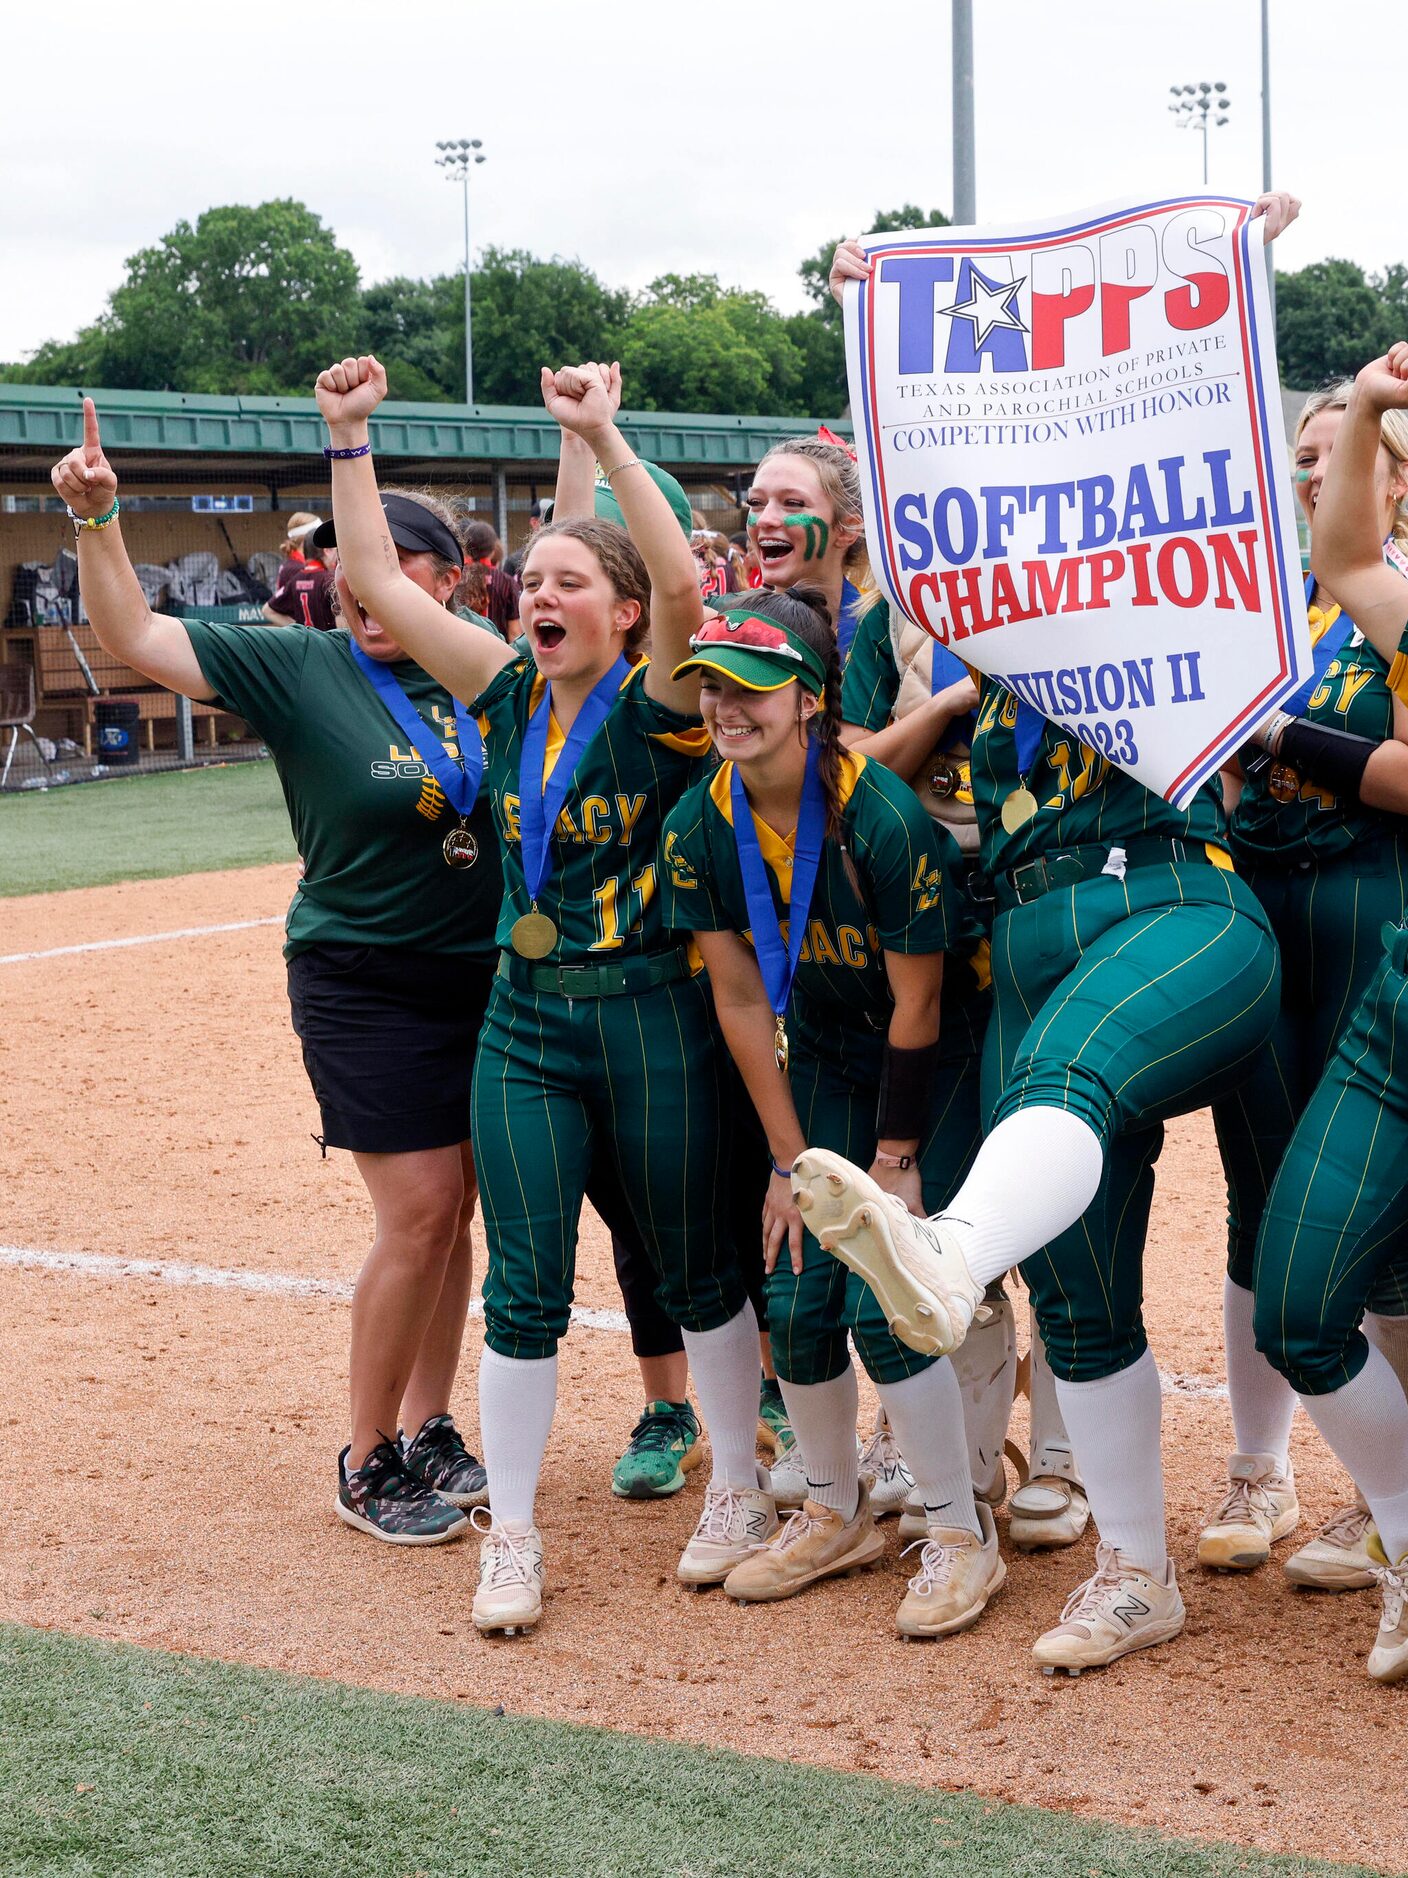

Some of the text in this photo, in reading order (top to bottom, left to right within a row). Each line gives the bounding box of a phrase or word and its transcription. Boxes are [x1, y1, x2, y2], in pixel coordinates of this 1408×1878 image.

[880, 208, 1231, 376] TAPPS
[896, 335, 1228, 399] TEXAS ASSOCIATION OF PRIVATE
[922, 362, 1204, 419] AND PAROCHIAL SCHOOLS
[893, 382, 1232, 453] COMPETITION WITH HONOR
[893, 448, 1255, 572] SOFTBALL
[909, 529, 1262, 647] CHAMPION
[1166, 651, 1206, 704] II
[587, 862, 658, 952] 11
